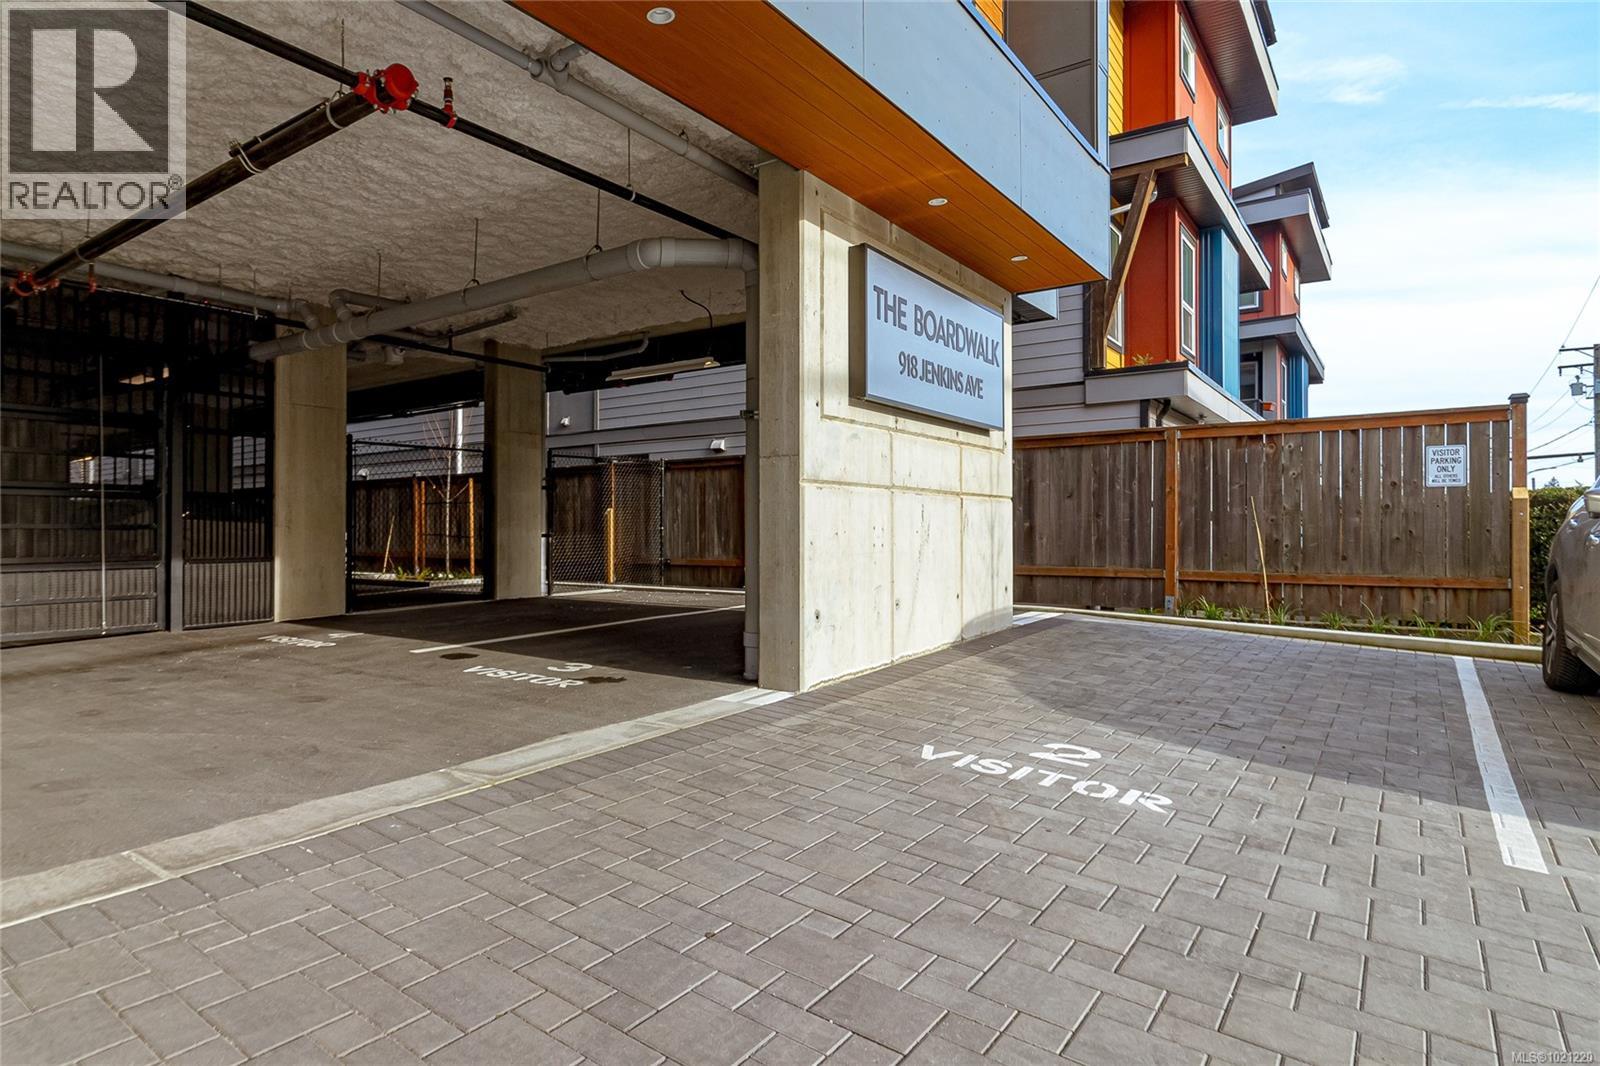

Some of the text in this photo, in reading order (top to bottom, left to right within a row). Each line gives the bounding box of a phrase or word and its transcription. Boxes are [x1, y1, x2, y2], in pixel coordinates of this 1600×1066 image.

[873, 285, 1000, 367] THE BOARDWALK
[898, 351, 984, 399] 918 JENKINS AVE
[1430, 457, 1462, 465] PARKING
[1436, 465, 1456, 473] ONLY
[463, 665, 584, 688] VISITOR
[547, 662, 593, 672] 3
[1029, 743, 1102, 768] 2
[920, 744, 1174, 814] VISITOR
